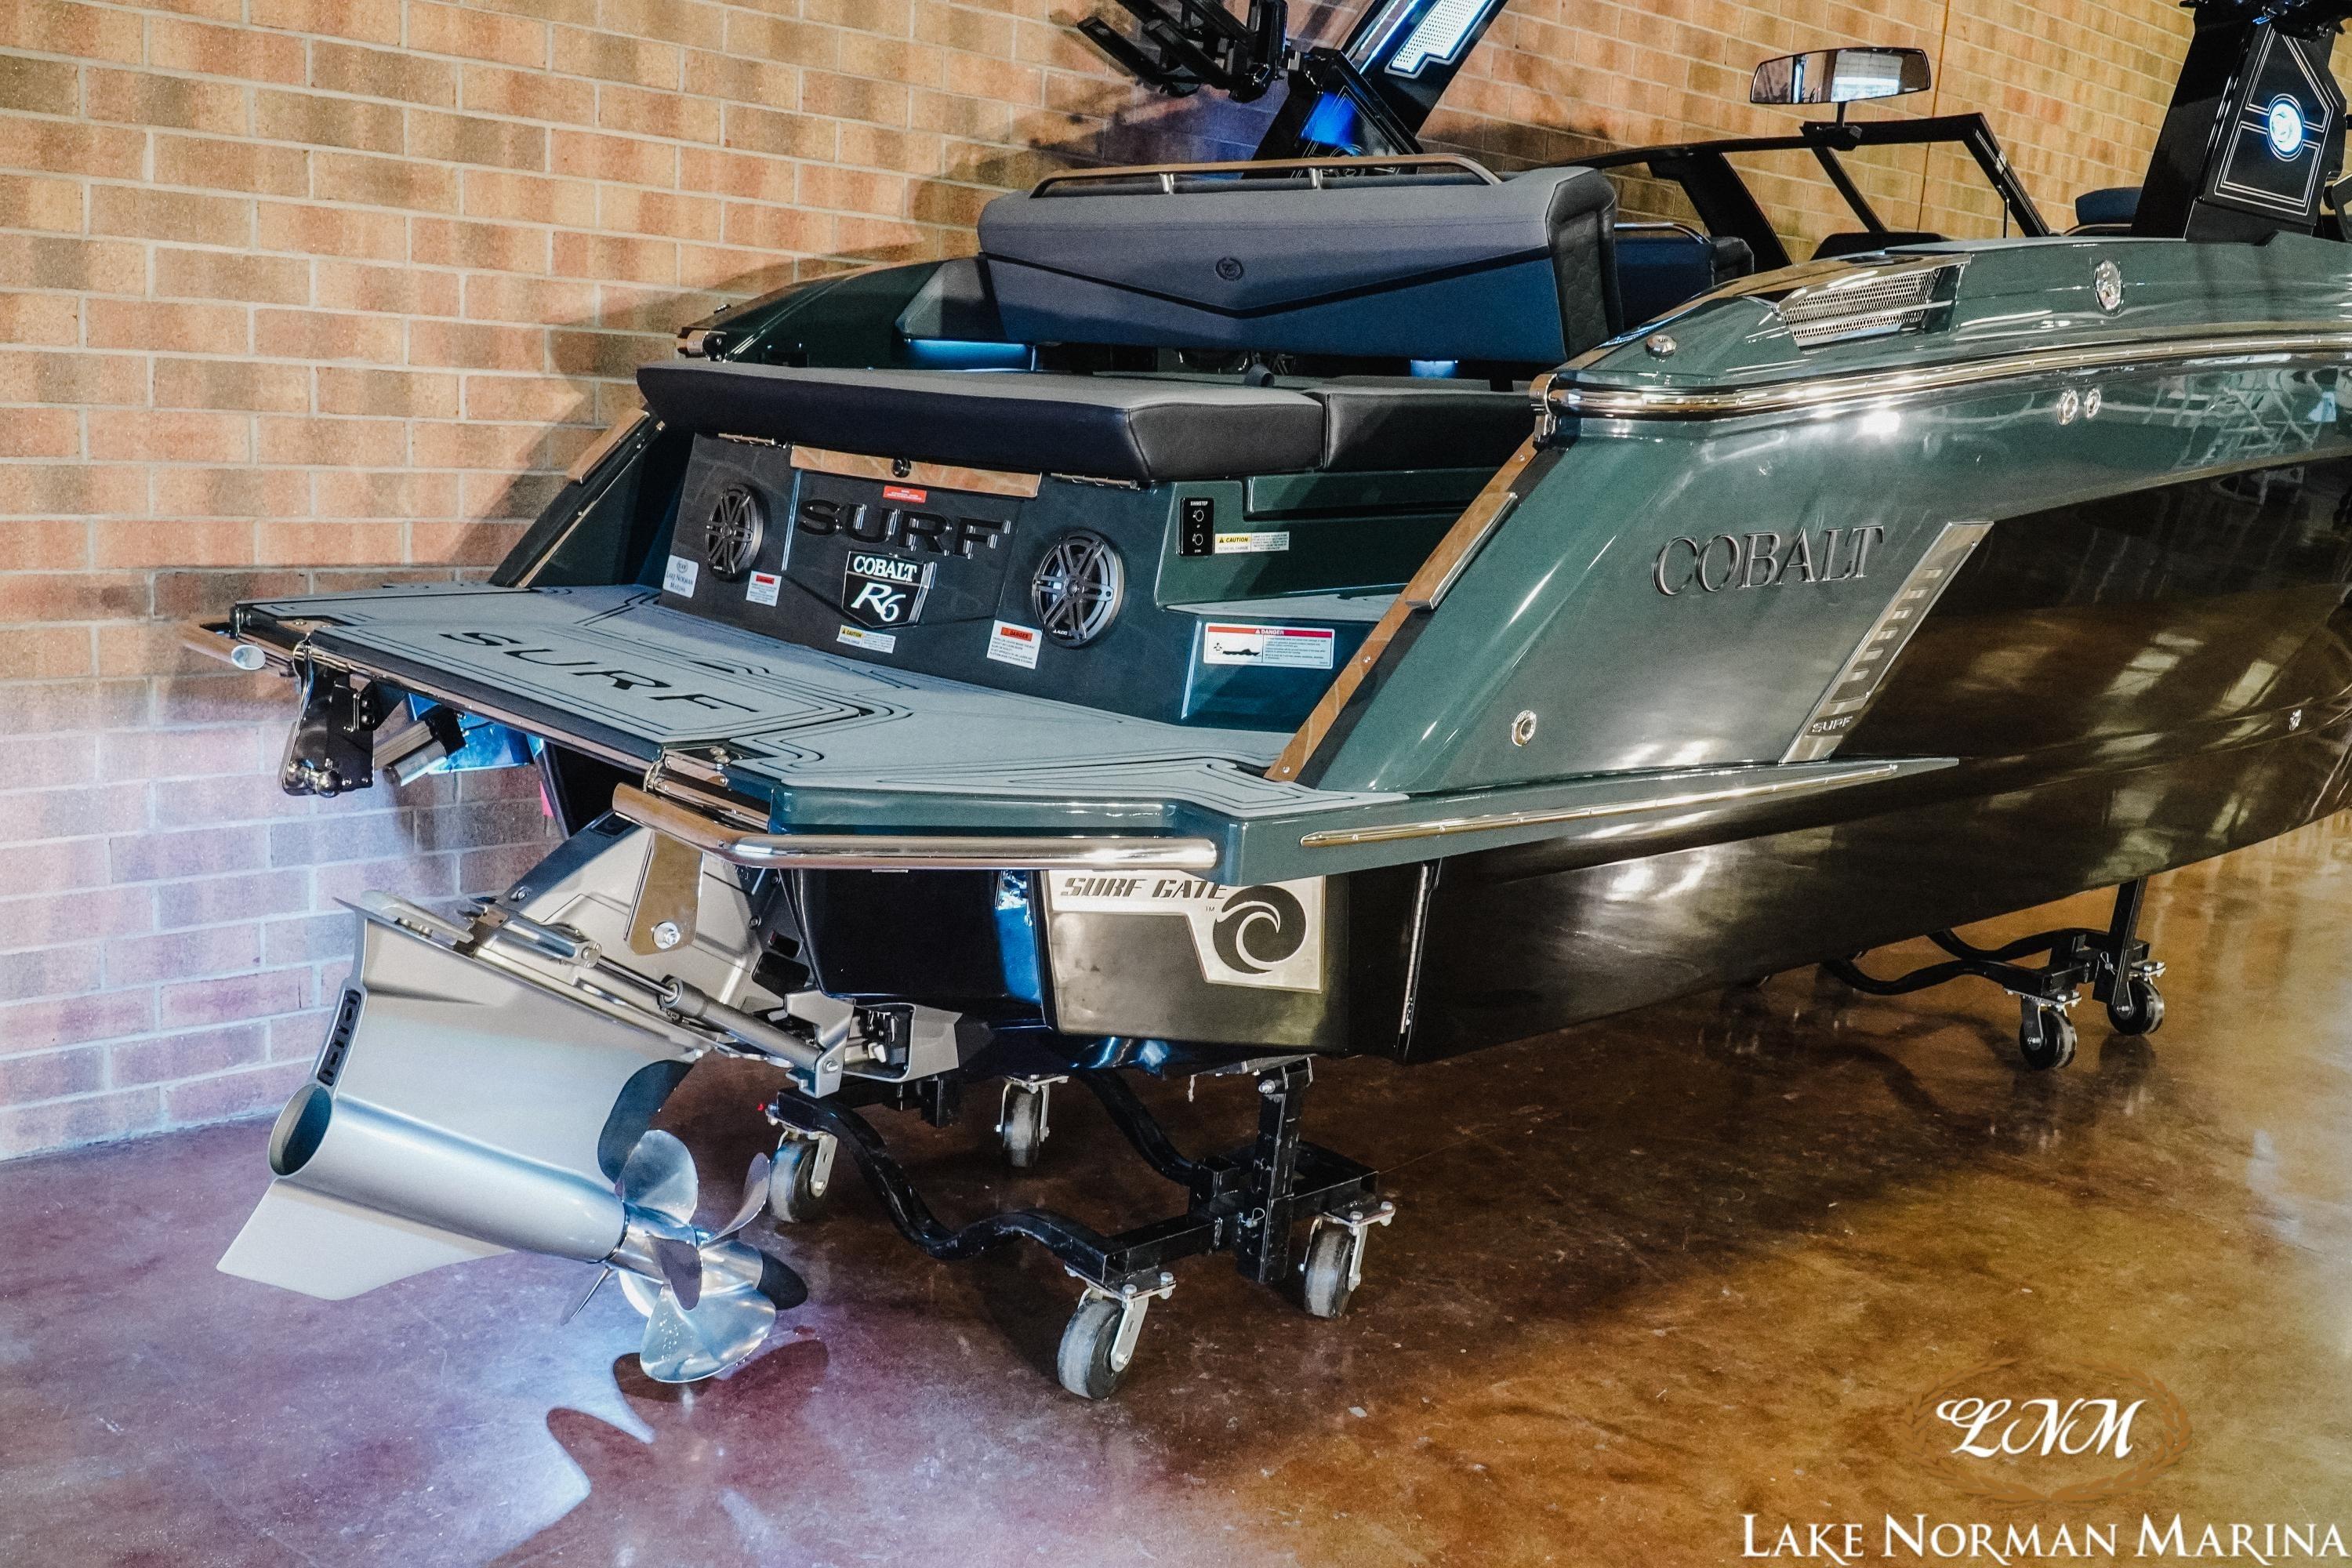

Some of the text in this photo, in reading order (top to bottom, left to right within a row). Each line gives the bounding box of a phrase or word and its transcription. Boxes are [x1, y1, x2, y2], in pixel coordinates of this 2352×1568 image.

[797, 499, 1011, 559] SURF
[853, 555, 917, 583] COBALT
[1651, 524, 1884, 597] COBALT
[851, 582, 906, 622] R6
[847, 630, 862, 638] CAUTION
[1010, 630, 1029, 639] DANGER
[439, 632, 760, 713] SURF
[1811, 716, 1853, 733] SURF
[1060, 877, 1228, 900] SURF GATE
